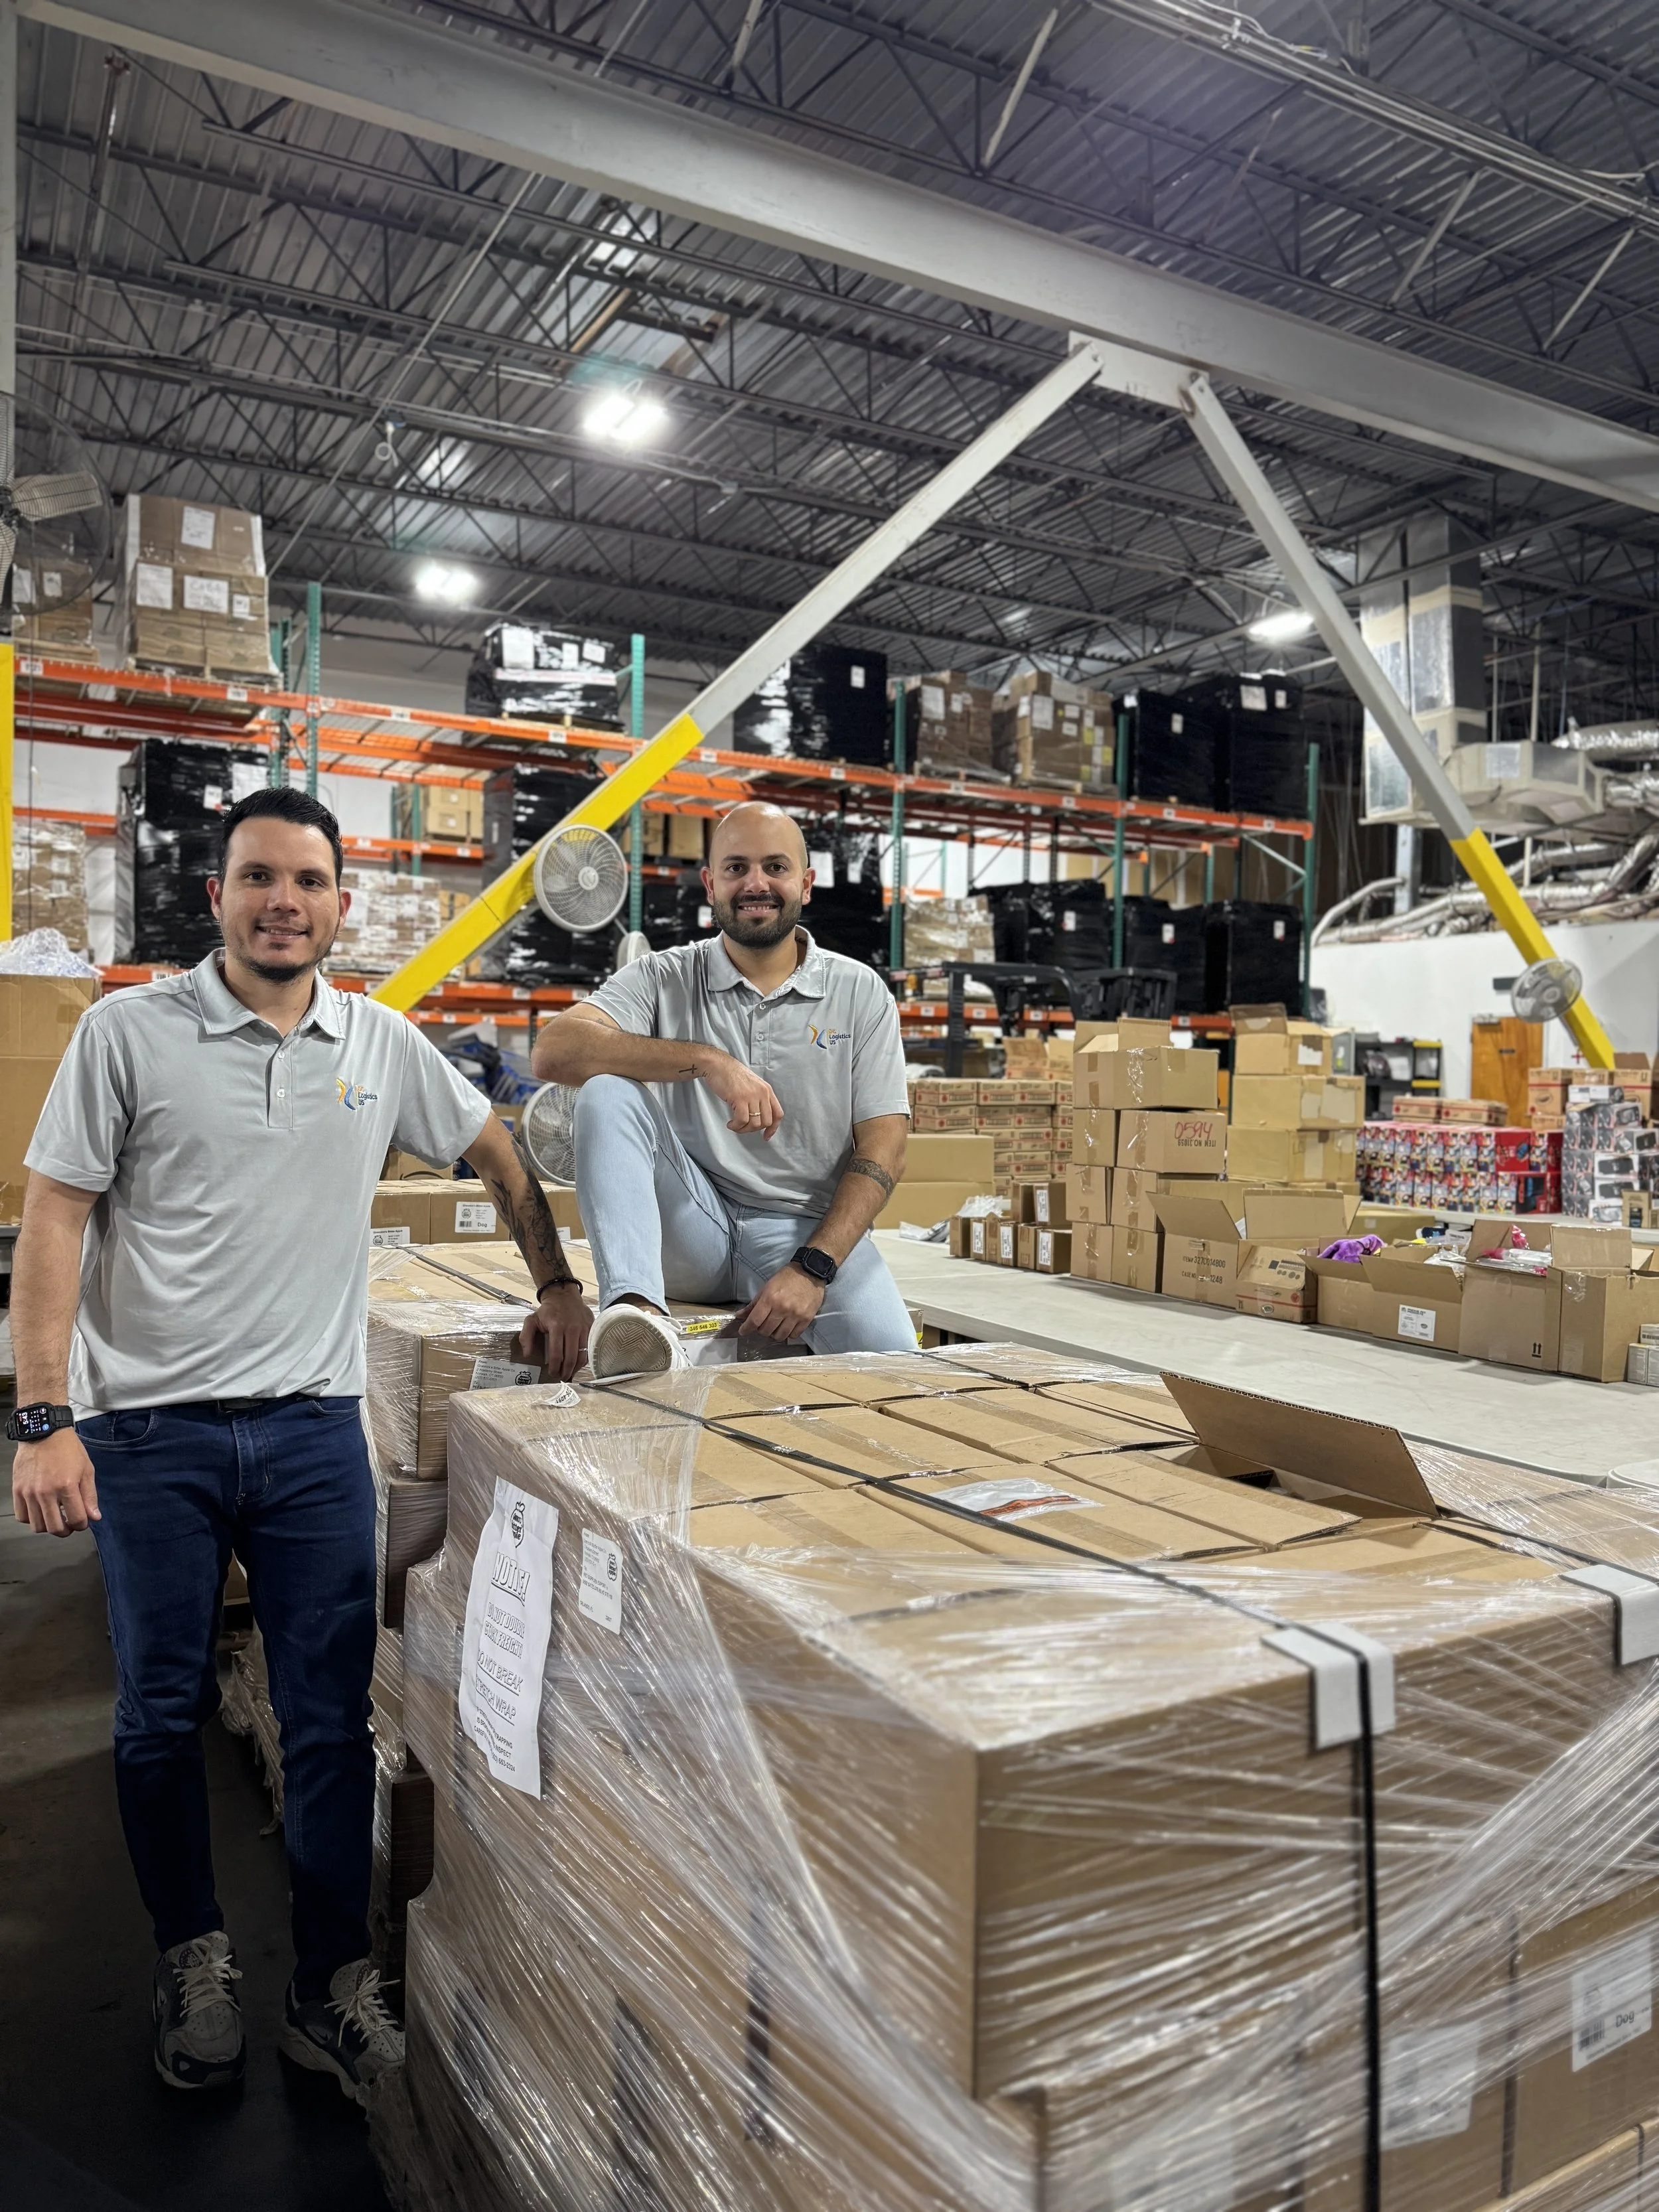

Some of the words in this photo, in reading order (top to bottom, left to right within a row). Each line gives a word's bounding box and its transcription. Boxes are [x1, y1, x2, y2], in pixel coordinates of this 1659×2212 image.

[358, 1092, 378, 1100] Logistics
[1175, 1121, 1213, 1140] 0594
[494, 1606, 506, 1626] NOT
[484, 1655, 496, 1675] NOT
[496, 1664, 523, 1692] BREAK
[495, 1694, 516, 1720] WRAP
[1615, 2010, 1635, 2028] Dog
